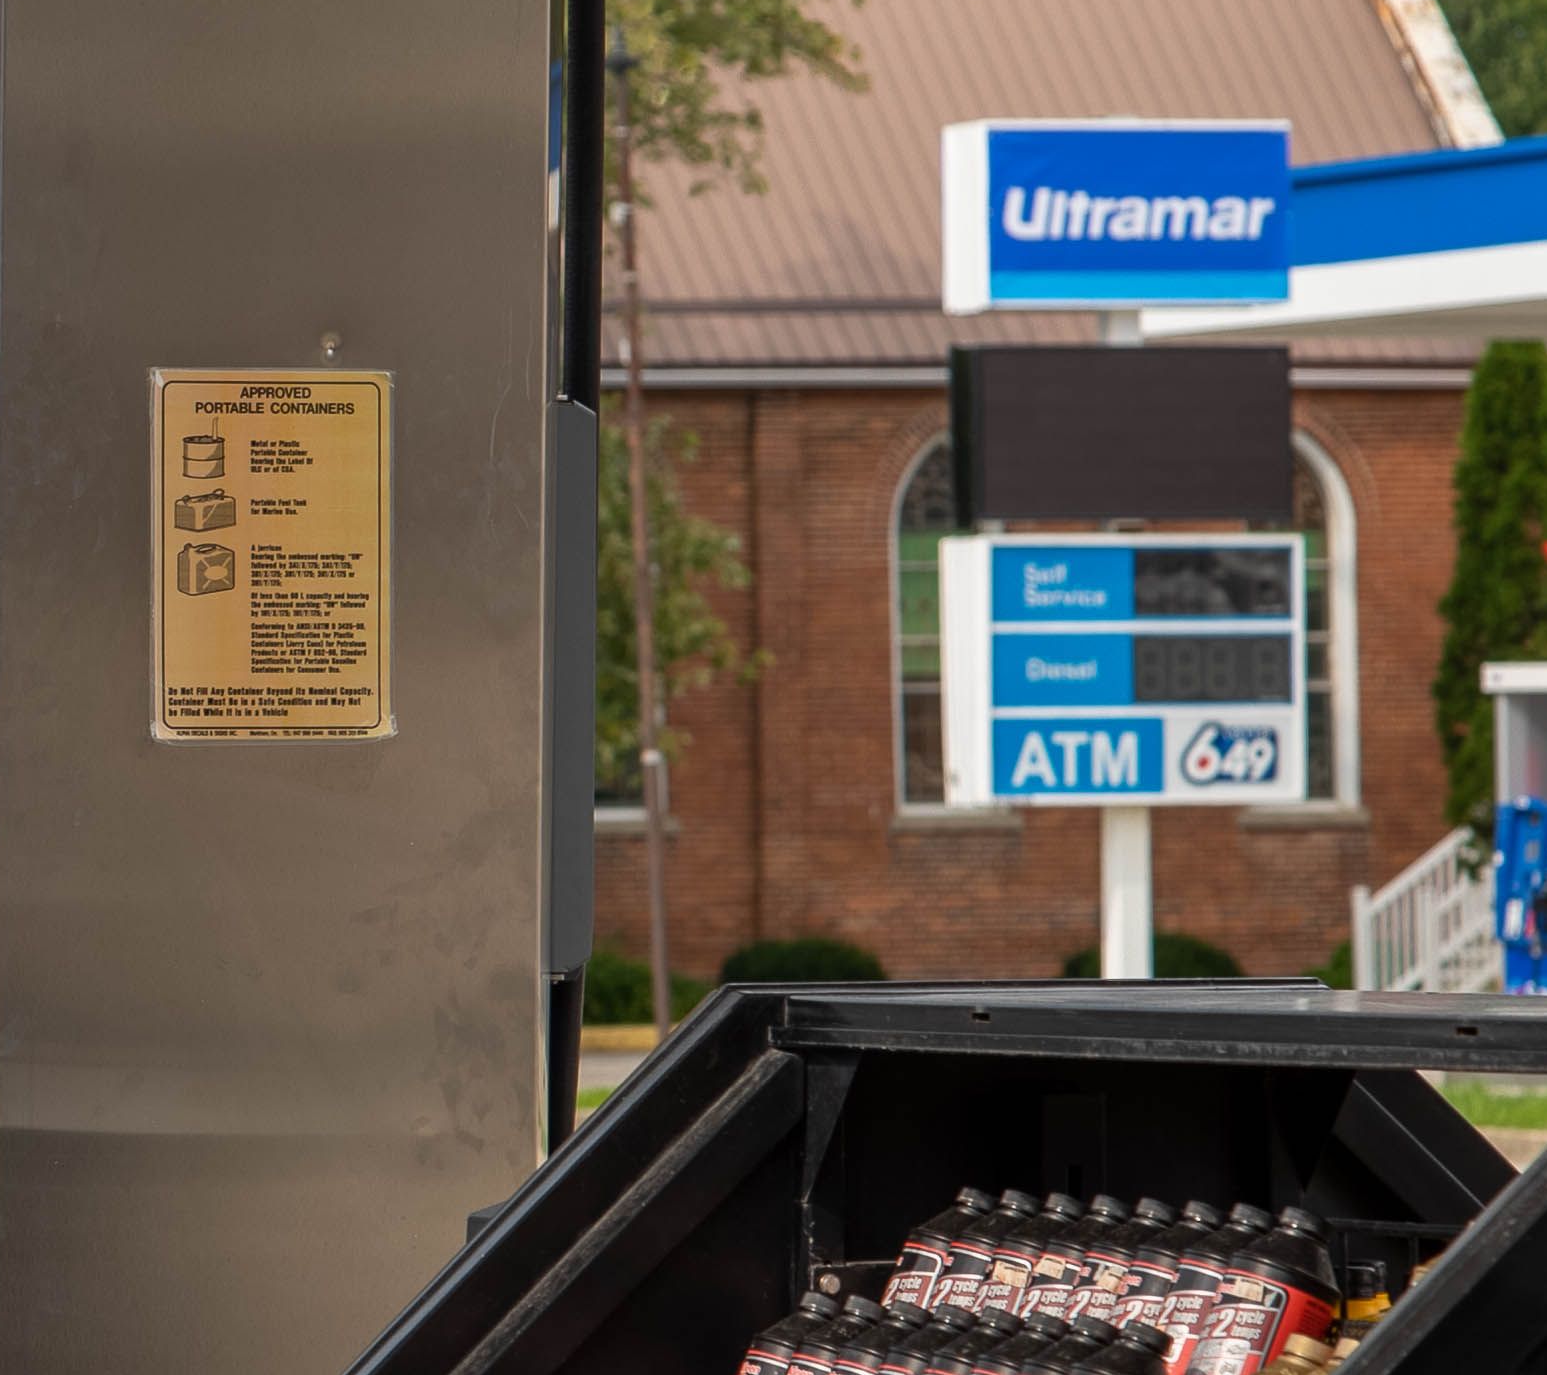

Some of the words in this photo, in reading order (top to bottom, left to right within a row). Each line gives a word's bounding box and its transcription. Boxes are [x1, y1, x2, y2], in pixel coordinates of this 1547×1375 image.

[1003, 186, 1274, 241] Ultramar
[240, 387, 311, 399] APPROVED
[195, 402, 264, 414] PORTABLE
[270, 403, 355, 414] CONTAINERS
[1023, 563, 1067, 584] Self
[1023, 586, 1106, 607] Service
[1025, 658, 1098, 682] Diesel
[168, 697, 204, 706] Container
[228, 687, 264, 696] Container
[1011, 731, 1139, 788] ATM
[1212, 1308, 1236, 1338] 2
